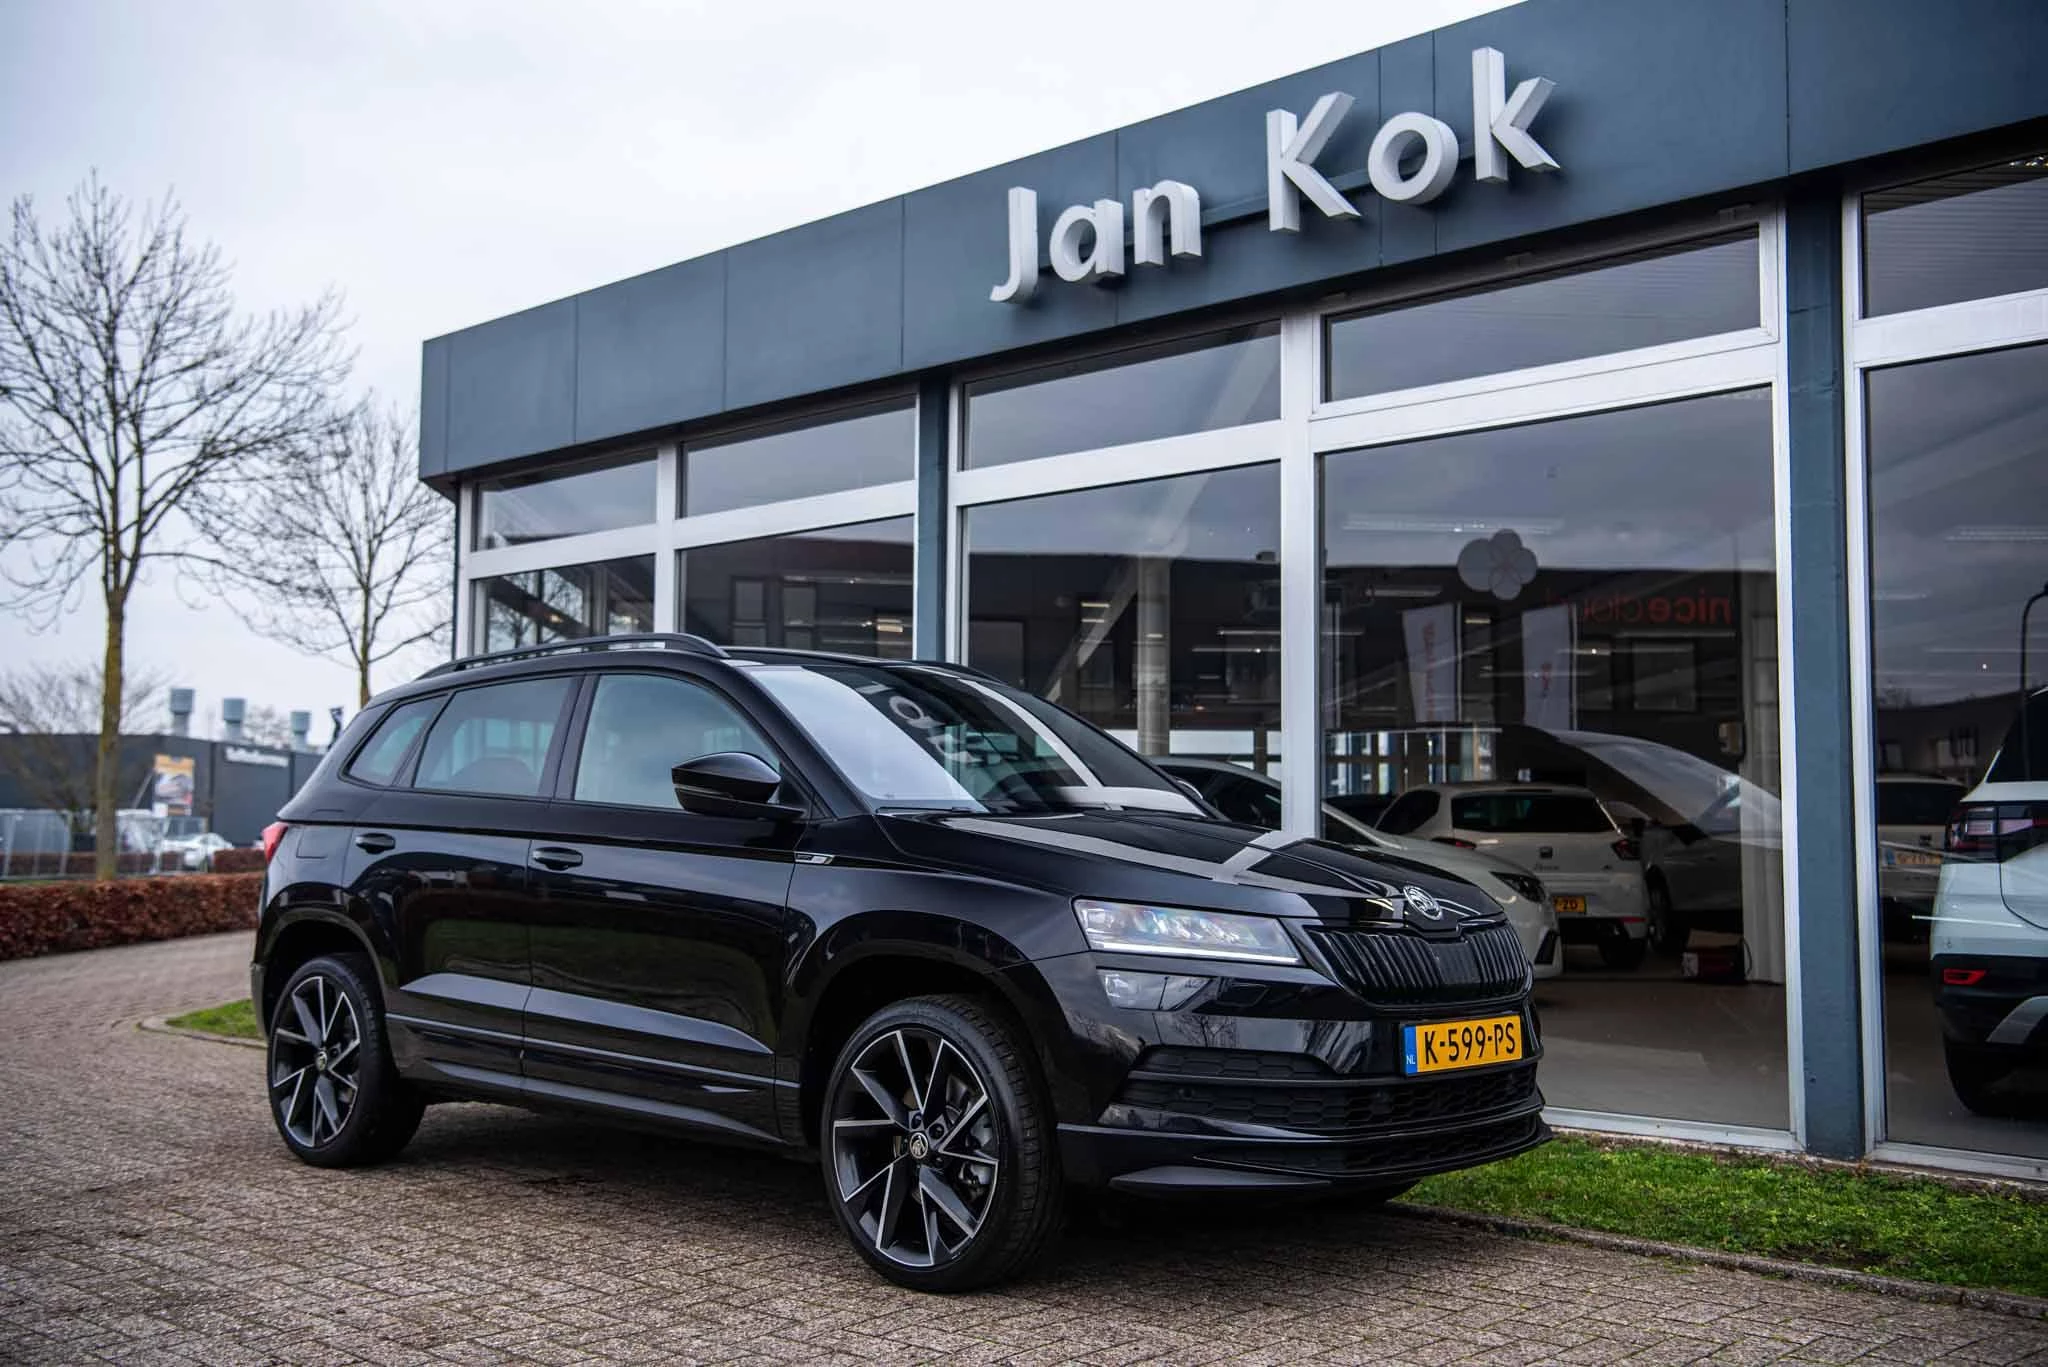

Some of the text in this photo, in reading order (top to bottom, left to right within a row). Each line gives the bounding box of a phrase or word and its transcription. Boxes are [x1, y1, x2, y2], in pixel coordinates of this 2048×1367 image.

[989, 46, 1560, 302] Jan Kok
[1406, 1021, 1516, 1065] NL K-599-PS
